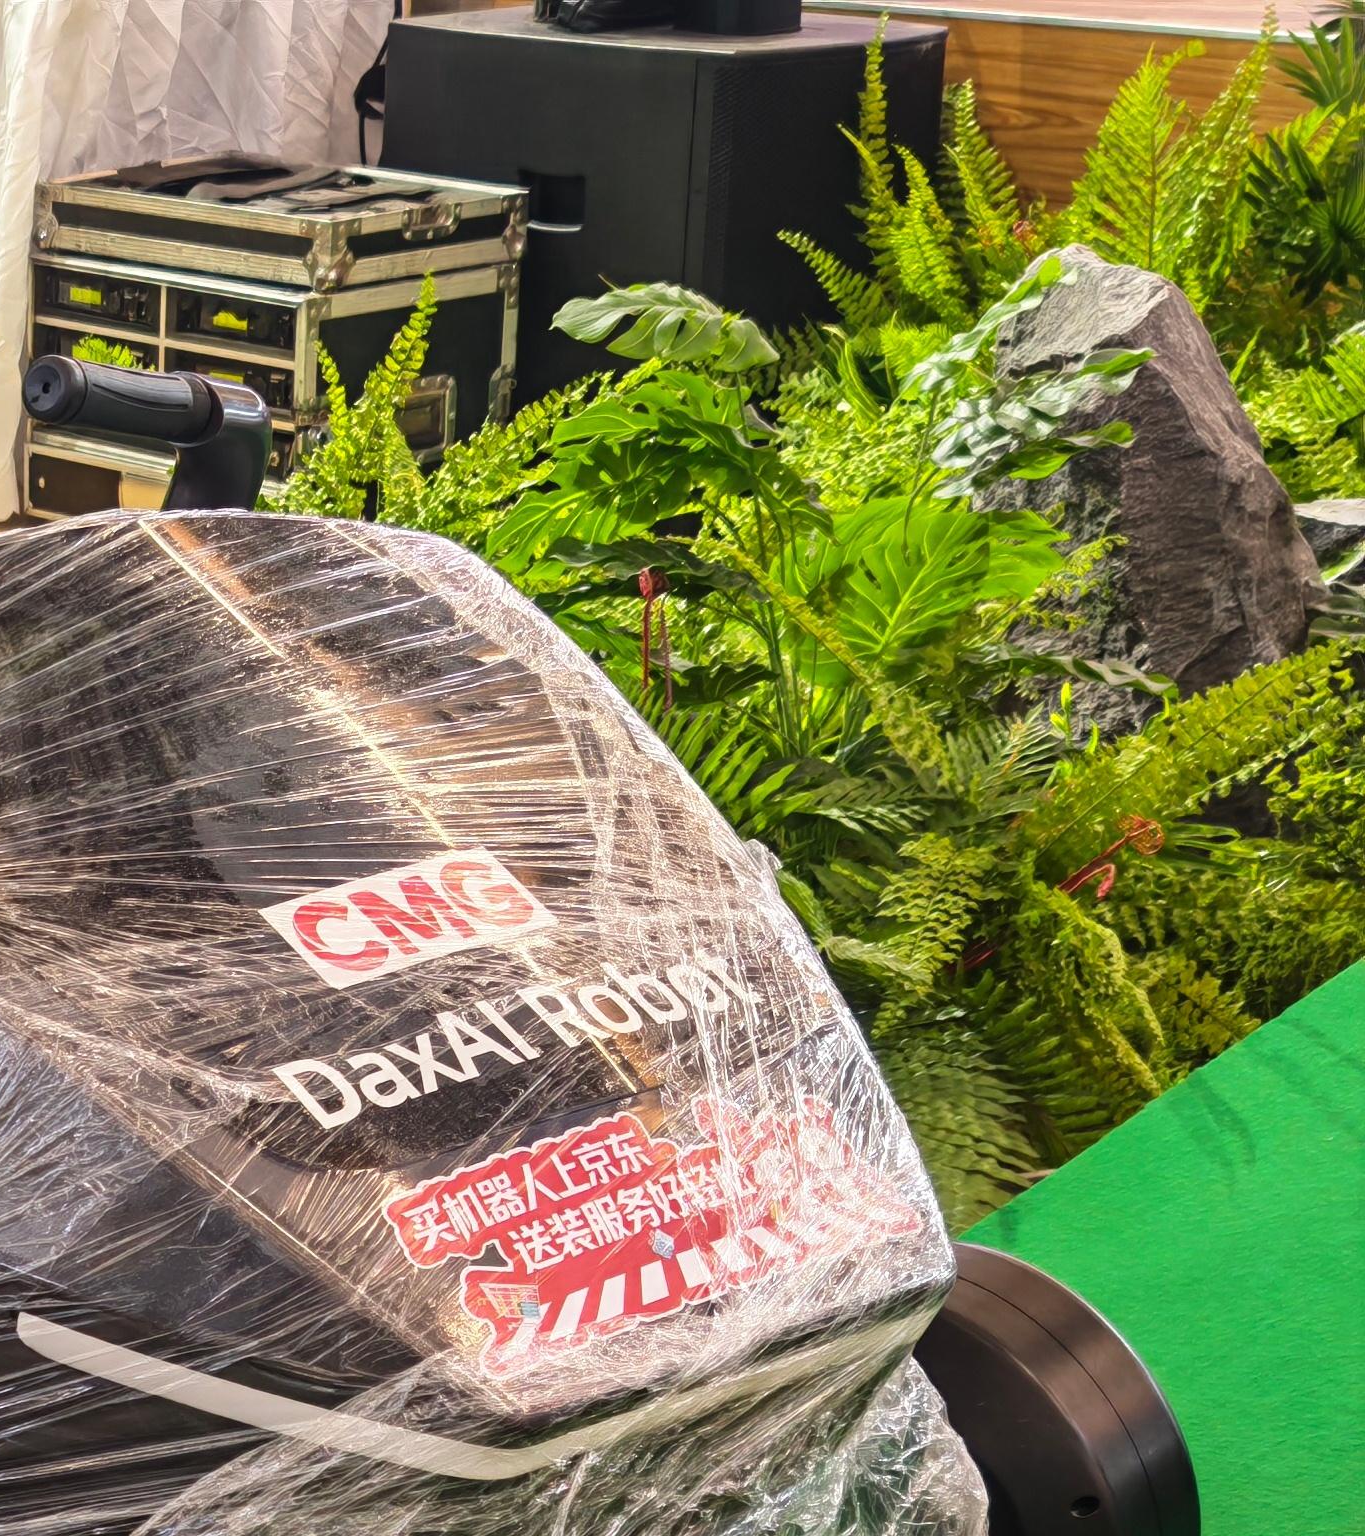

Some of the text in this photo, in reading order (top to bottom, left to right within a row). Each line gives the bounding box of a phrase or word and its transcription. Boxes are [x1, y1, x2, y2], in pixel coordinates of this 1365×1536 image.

[292, 860, 536, 971] CMG
[272, 997, 542, 1130] DaxAI
[403, 1130, 653, 1254] 买机器人上京东
